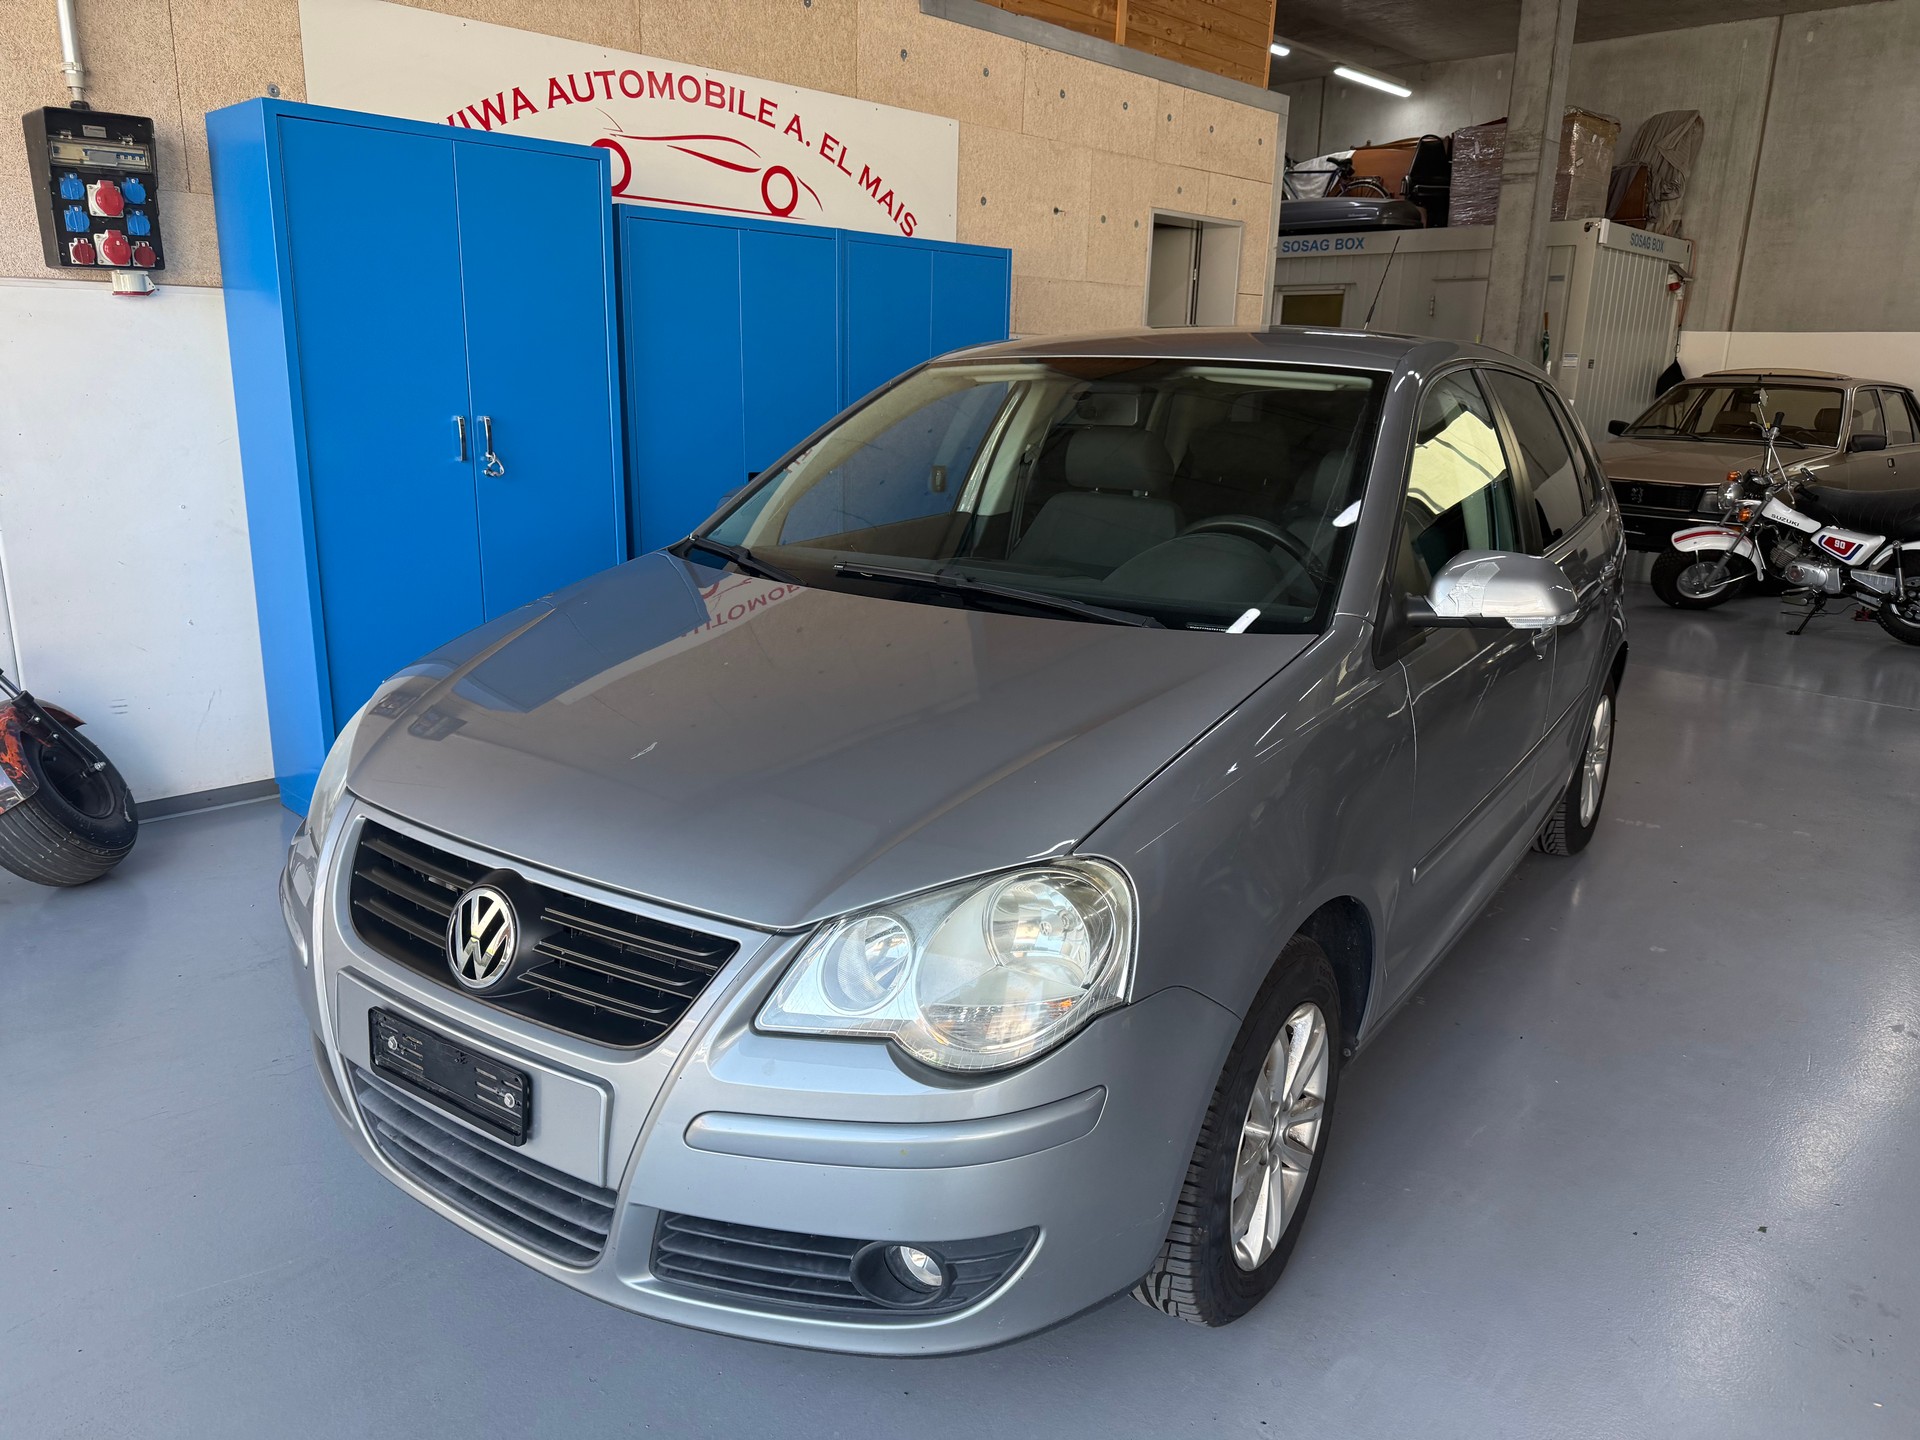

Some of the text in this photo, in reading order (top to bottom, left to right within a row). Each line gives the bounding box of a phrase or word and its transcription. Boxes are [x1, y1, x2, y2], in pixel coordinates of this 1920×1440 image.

[547, 69, 778, 129] AUTOMOBILE
[783, 113, 811, 148] A.
[819, 132, 852, 177] EL
[858, 164, 918, 238] MAIS
[1281, 237, 1365, 253] SOSAG BOX
[1630, 232, 1665, 253] SOSAG BOX
[1771, 513, 1800, 527] SUZUKI
[1834, 539, 1846, 549] 90
